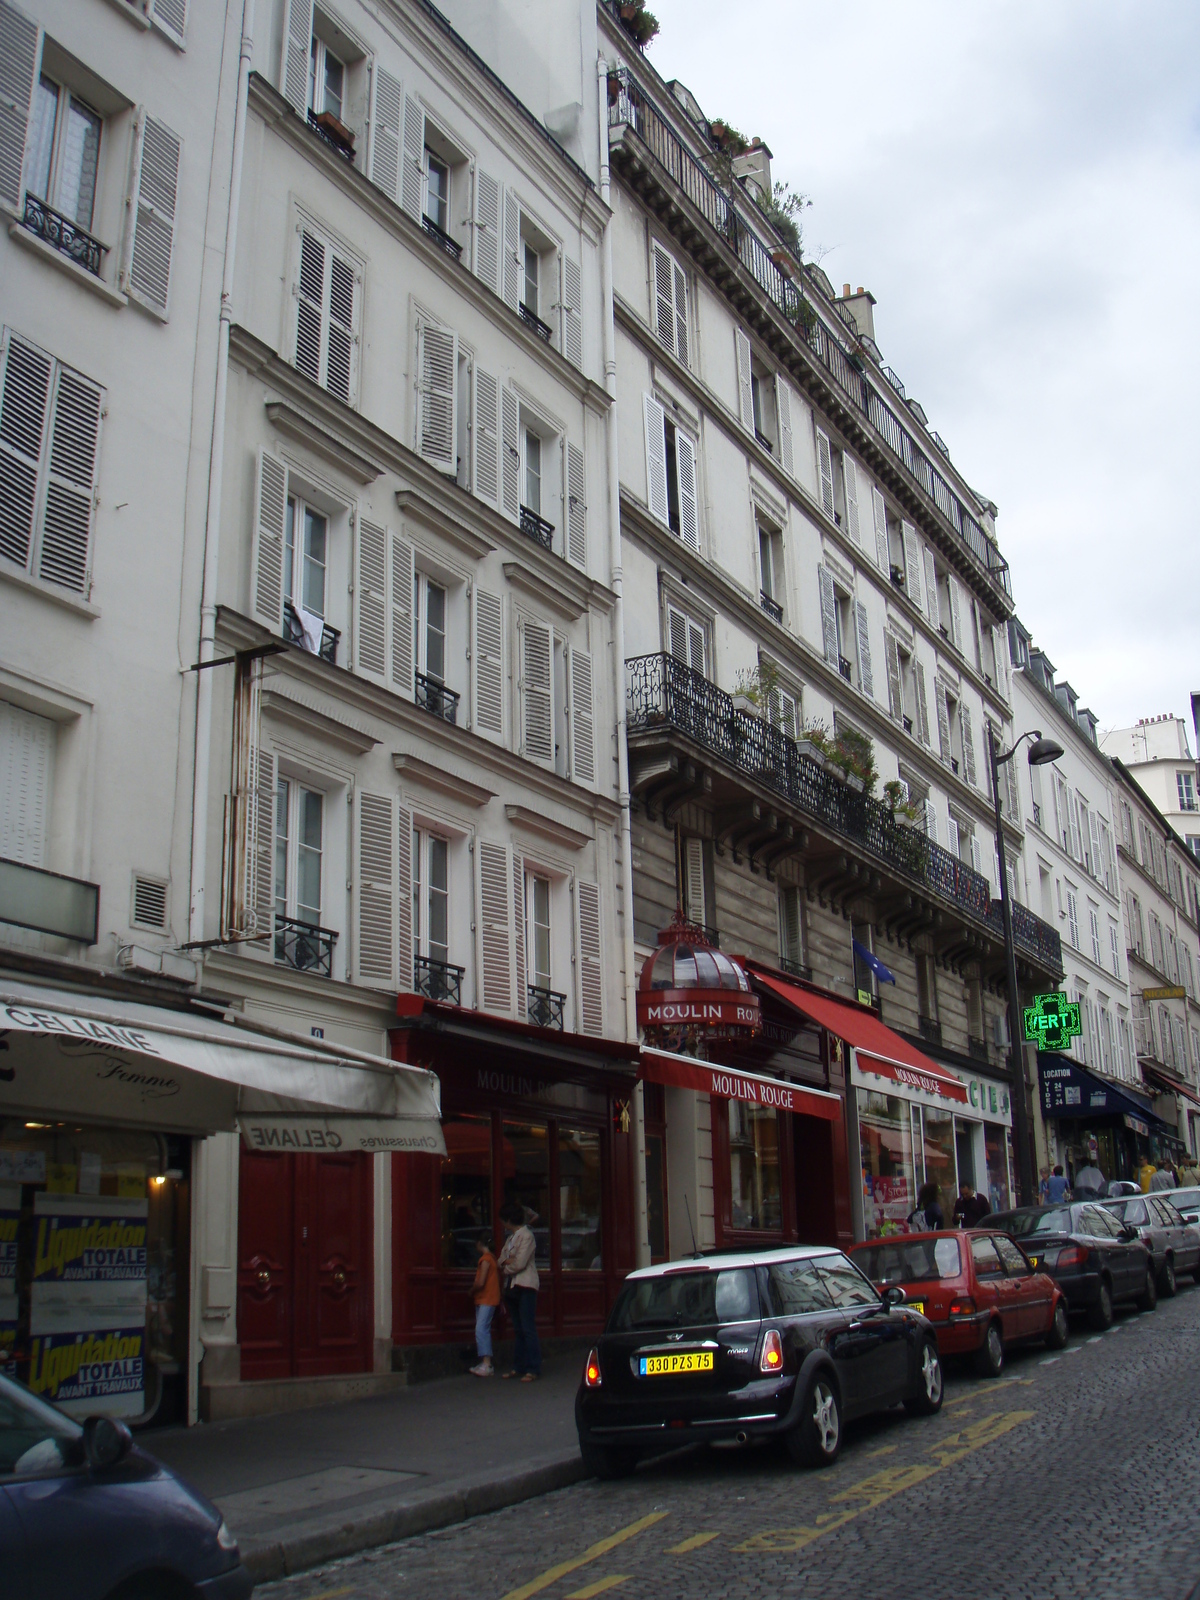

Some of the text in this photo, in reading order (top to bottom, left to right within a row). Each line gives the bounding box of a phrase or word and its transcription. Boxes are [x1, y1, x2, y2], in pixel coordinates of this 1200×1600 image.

[1144, 988, 1184, 998] NICOLAS
[648, 1004, 722, 1020] MOULIN
[6, 1007, 160, 1054] CELIANE
[96, 1056, 181, 1098] Femme
[477, 1068, 533, 1097] MOULIN
[894, 1067, 941, 1093] MOULIN ROUGE
[1044, 1068, 1070, 1079] LOCATION
[712, 1072, 794, 1109] MOULIN ROUGE
[888, 1186, 906, 1197] STOP
[34, 1217, 146, 1279] Liquidation
[84, 1248, 146, 1265] TOTALE
[63, 1266, 146, 1280] AVANT TRAVAUX
[29, 1331, 142, 1398] Liquidation
[80, 1359, 142, 1381] TOTALE
[649, 1357, 669, 1372] 330
[672, 1356, 692, 1371] PZS
[696, 1354, 710, 1369] 75
[58, 1376, 143, 1400] AVANT TRAVAUX
